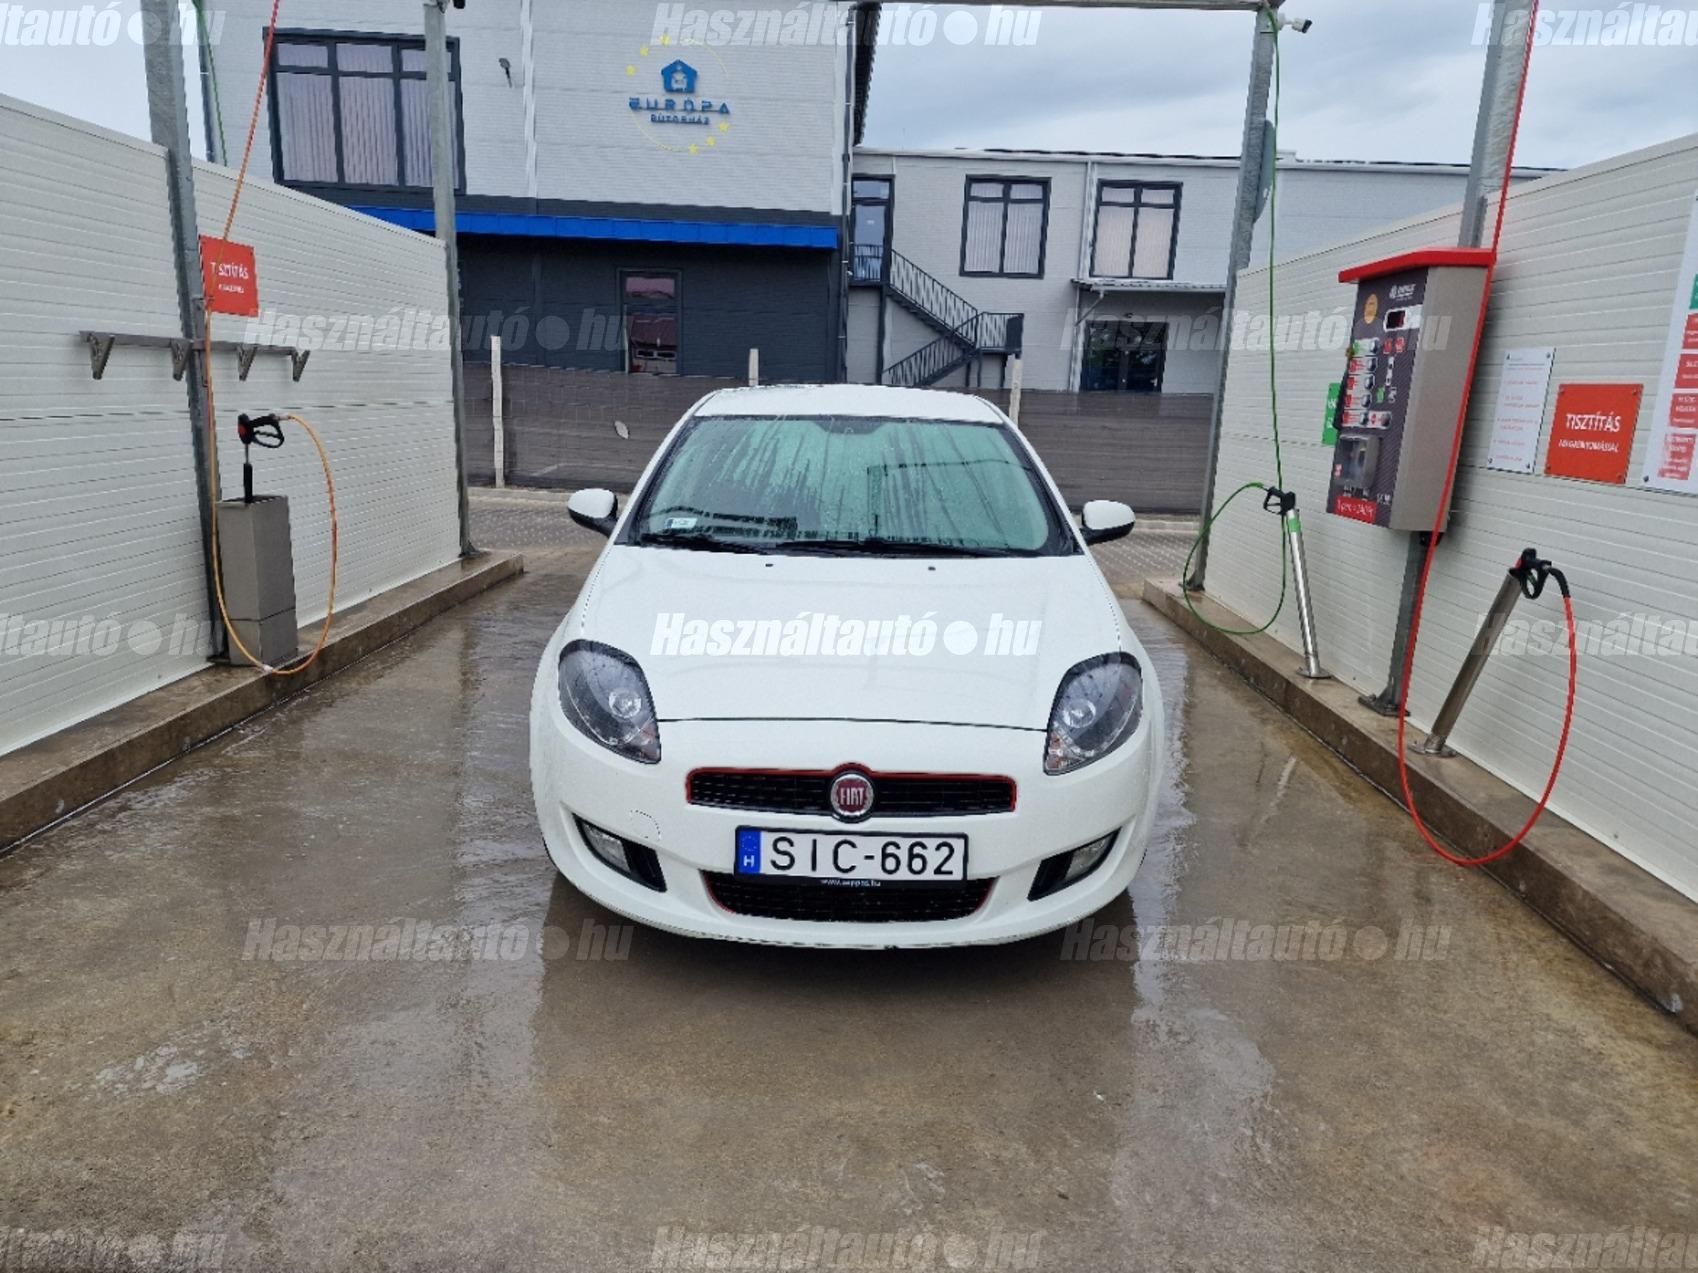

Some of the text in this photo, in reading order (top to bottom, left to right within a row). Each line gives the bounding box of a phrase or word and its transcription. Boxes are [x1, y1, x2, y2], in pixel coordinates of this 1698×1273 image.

[1566, 411, 1621, 432] TISZTÍTÁS
[839, 786, 865, 806] FIAT
[743, 855, 755, 868] H
[770, 836, 956, 876] SIC-662
